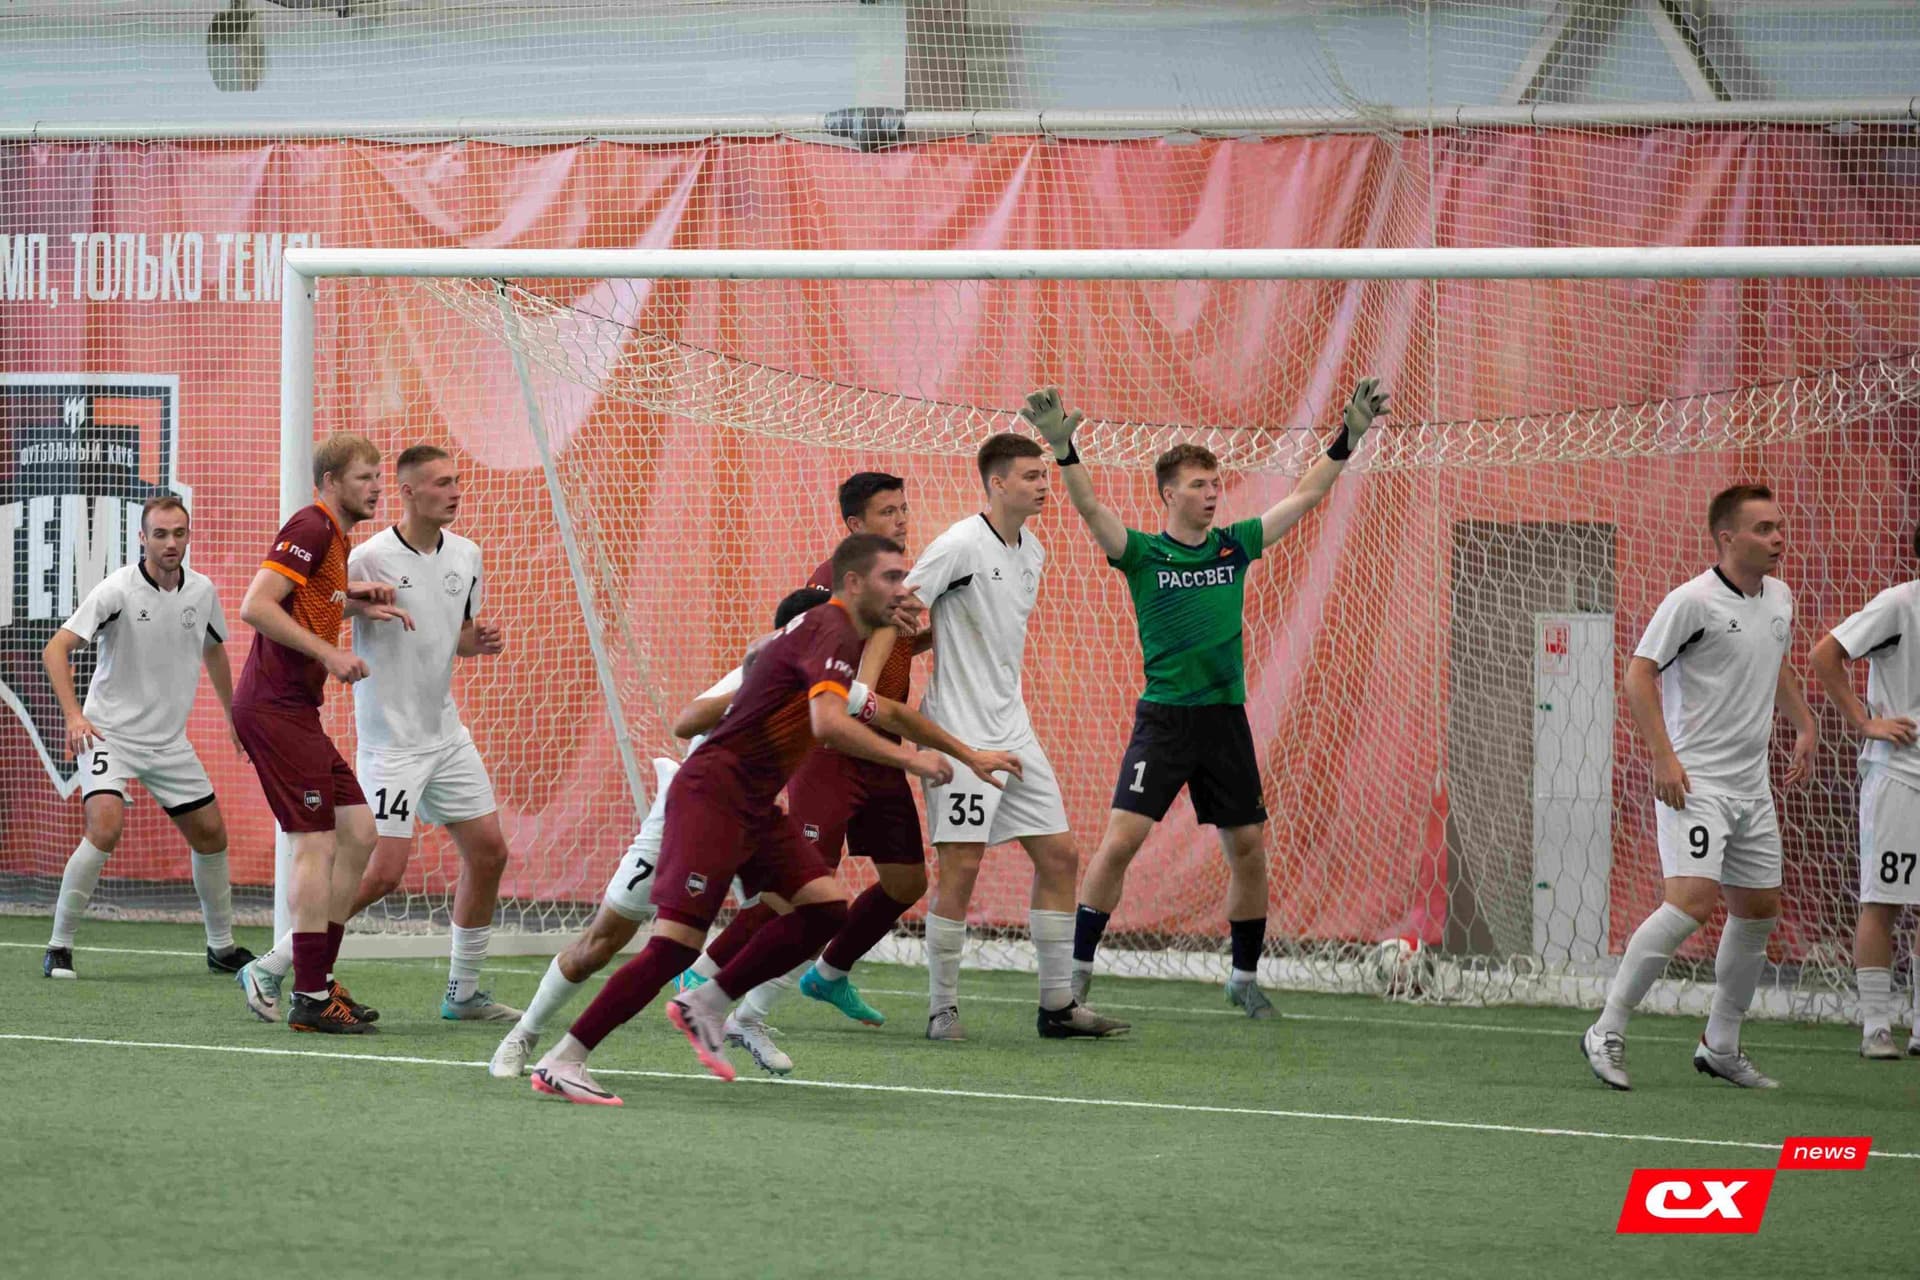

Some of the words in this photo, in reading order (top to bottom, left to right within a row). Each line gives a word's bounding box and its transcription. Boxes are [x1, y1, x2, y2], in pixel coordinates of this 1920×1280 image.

[71, 232, 203, 303] ТОЛЬКО
[20, 440, 101, 466] ФУТБОЛЬНЫЙ
[108, 442, 134, 468] КЛУБ
[289, 544, 313, 562] ПСБ
[1157, 565, 1235, 589] РАССВЕТ
[91, 751, 109, 776] 5
[1130, 761, 1147, 793] 1
[375, 787, 410, 822] 14
[948, 793, 985, 826] 35
[1689, 825, 1710, 859] 9
[627, 857, 655, 891] 7
[1879, 851, 1917, 885] 87
